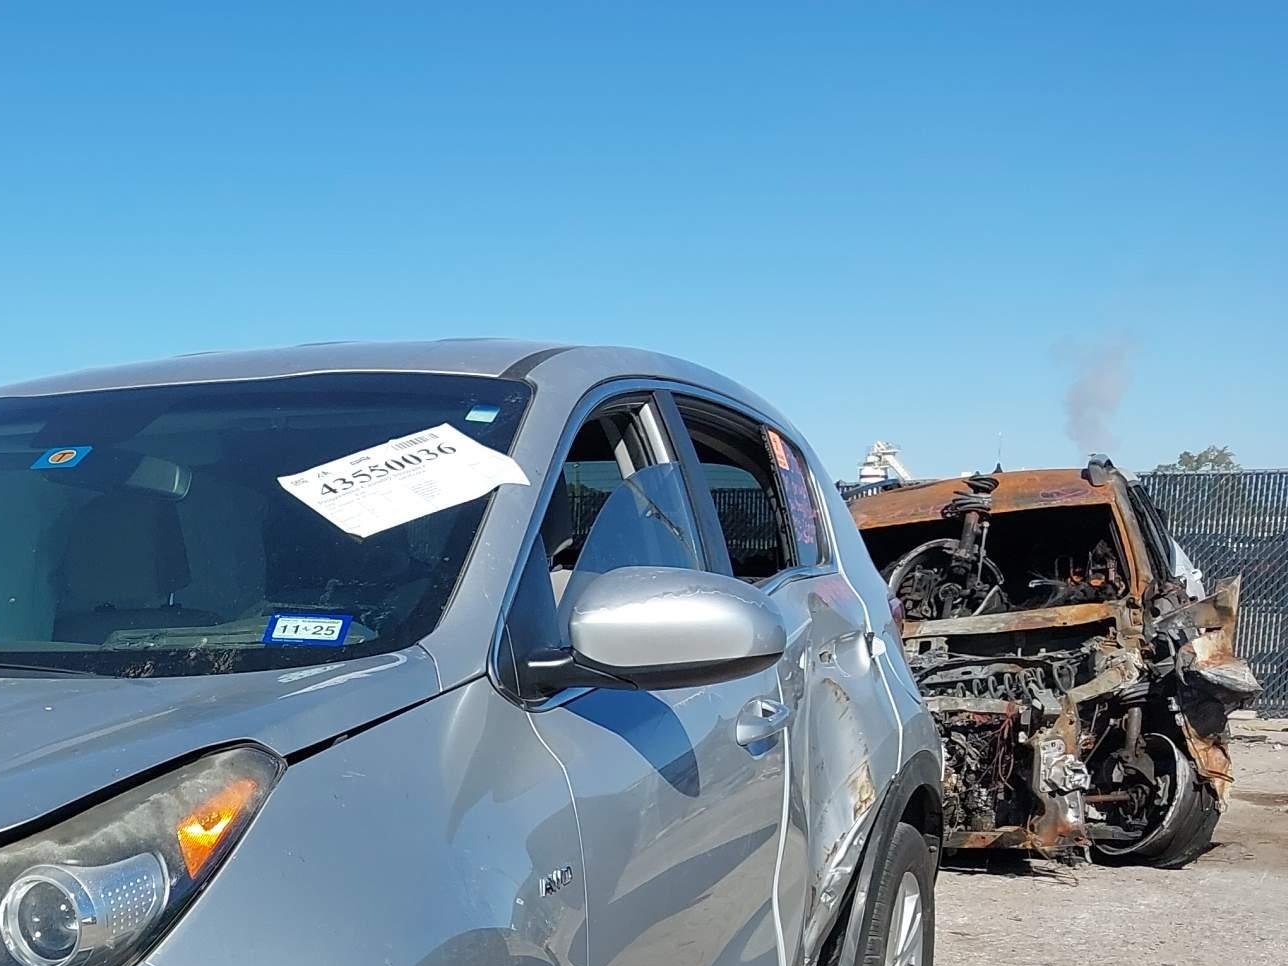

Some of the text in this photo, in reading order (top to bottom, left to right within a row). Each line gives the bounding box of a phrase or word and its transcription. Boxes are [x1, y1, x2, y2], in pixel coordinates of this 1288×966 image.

[320, 442, 457, 496] 43550036
[280, 624, 337, 636] 11 25
[539, 866, 573, 897] AWD
